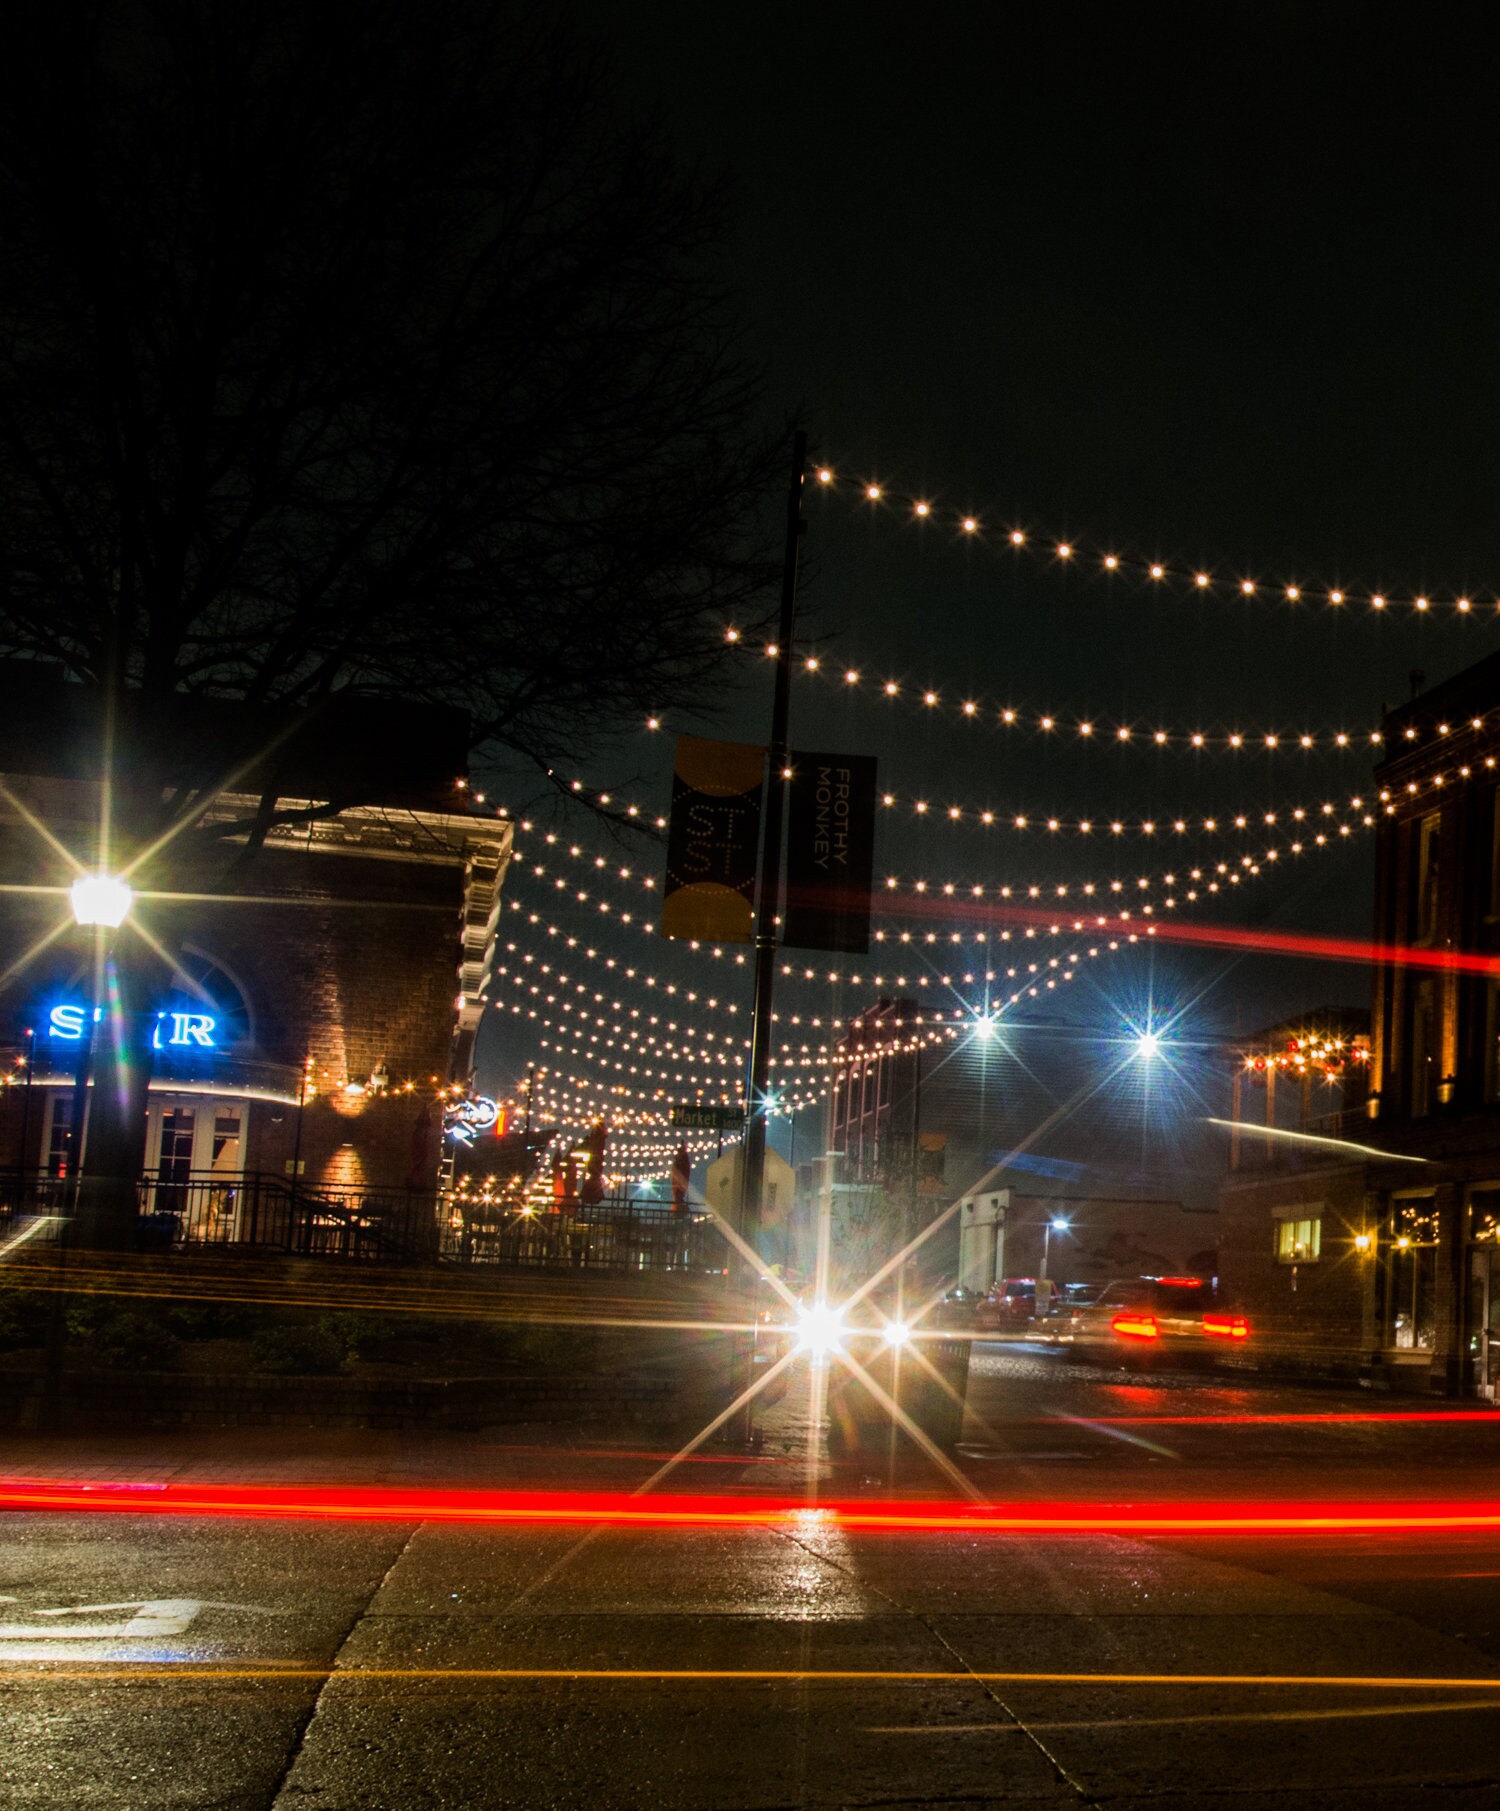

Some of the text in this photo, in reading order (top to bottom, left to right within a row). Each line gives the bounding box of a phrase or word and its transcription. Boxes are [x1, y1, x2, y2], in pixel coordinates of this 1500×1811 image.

[686, 803, 746, 840] ST
[814, 766, 832, 871] MONKEY
[833, 768, 851, 865] FROTHY
[683, 840, 743, 876] ST
[49, 1005, 216, 1048] SR
[674, 1108, 717, 1126] Market
